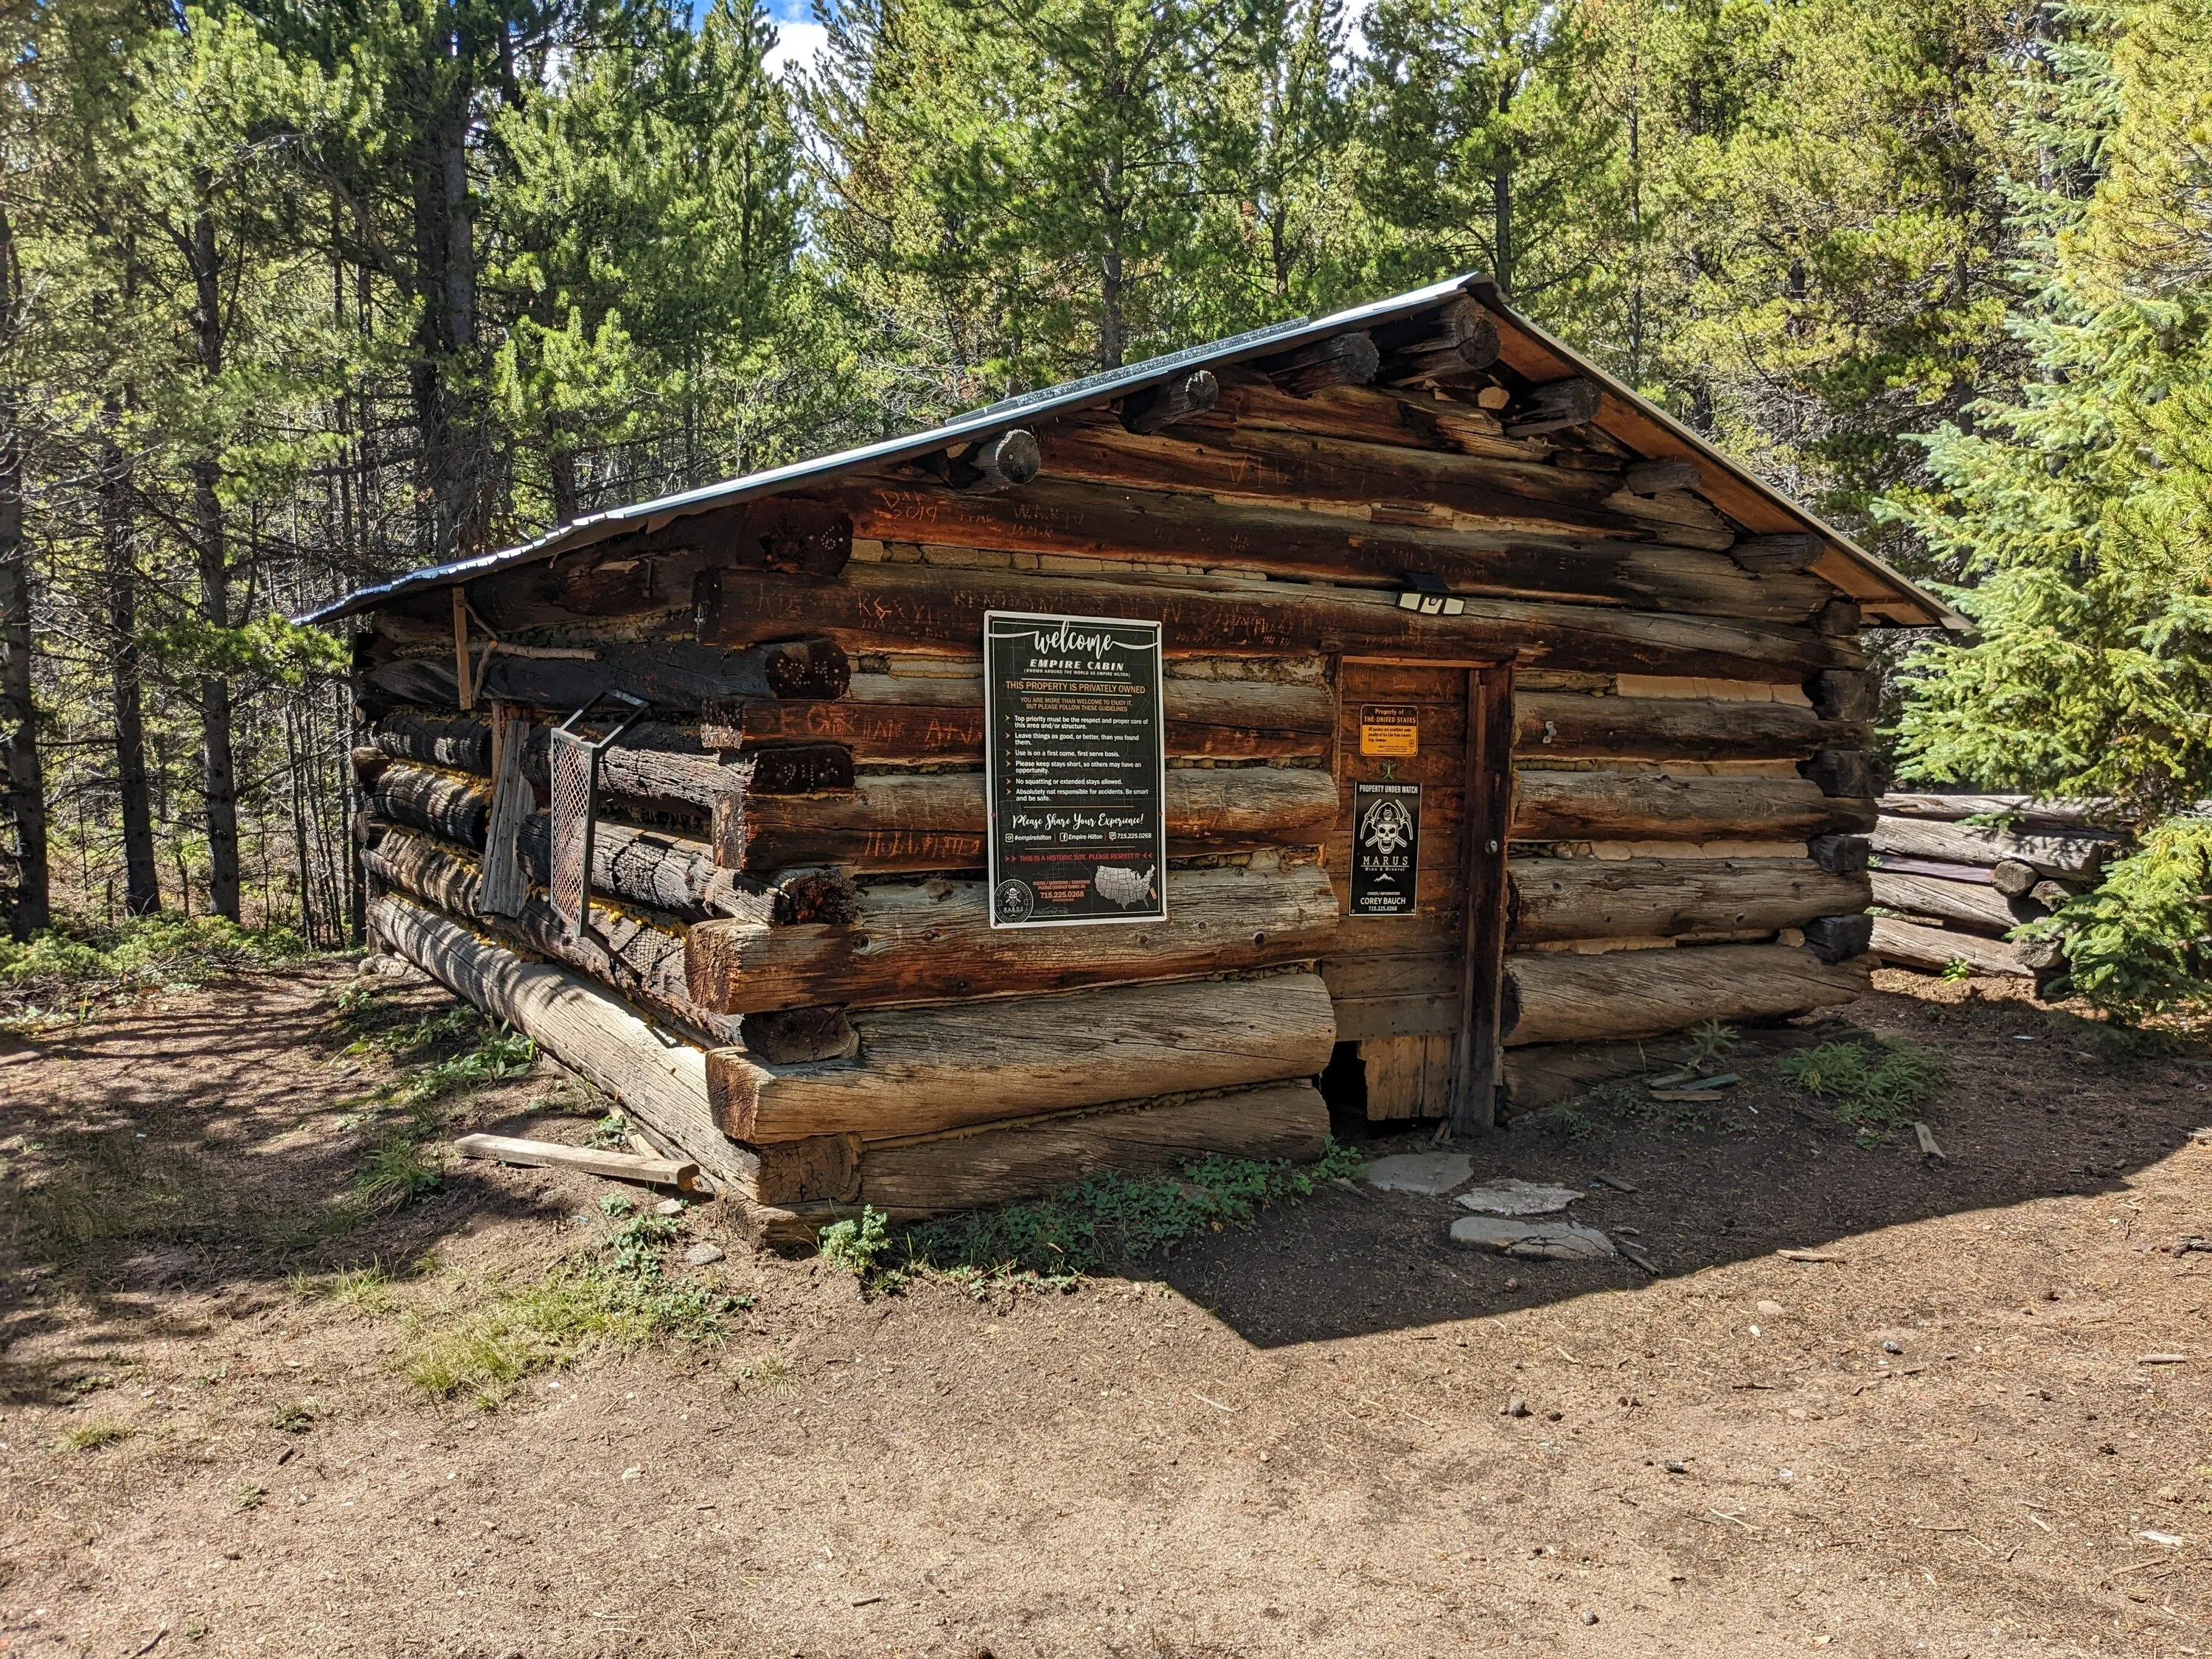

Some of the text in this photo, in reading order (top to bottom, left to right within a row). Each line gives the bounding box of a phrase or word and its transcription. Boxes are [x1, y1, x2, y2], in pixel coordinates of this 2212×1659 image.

[1034, 620, 1114, 660] welcome
[1029, 658, 1124, 671] EMPIRE CABIN
[1005, 681, 1146, 694] THIS PROPERTY IS PRIVATELY OWNED
[1015, 715, 1025, 723] Top
[1026, 715, 1046, 724] priority
[1081, 717, 1101, 725] respect
[1359, 785, 1418, 794] PROPERTY UNDER WATCH
[1012, 813, 1144, 830] Please Share Your Experience!
[1363, 855, 1408, 866] MARUS
[1040, 891, 1085, 899] 715.225.0268
